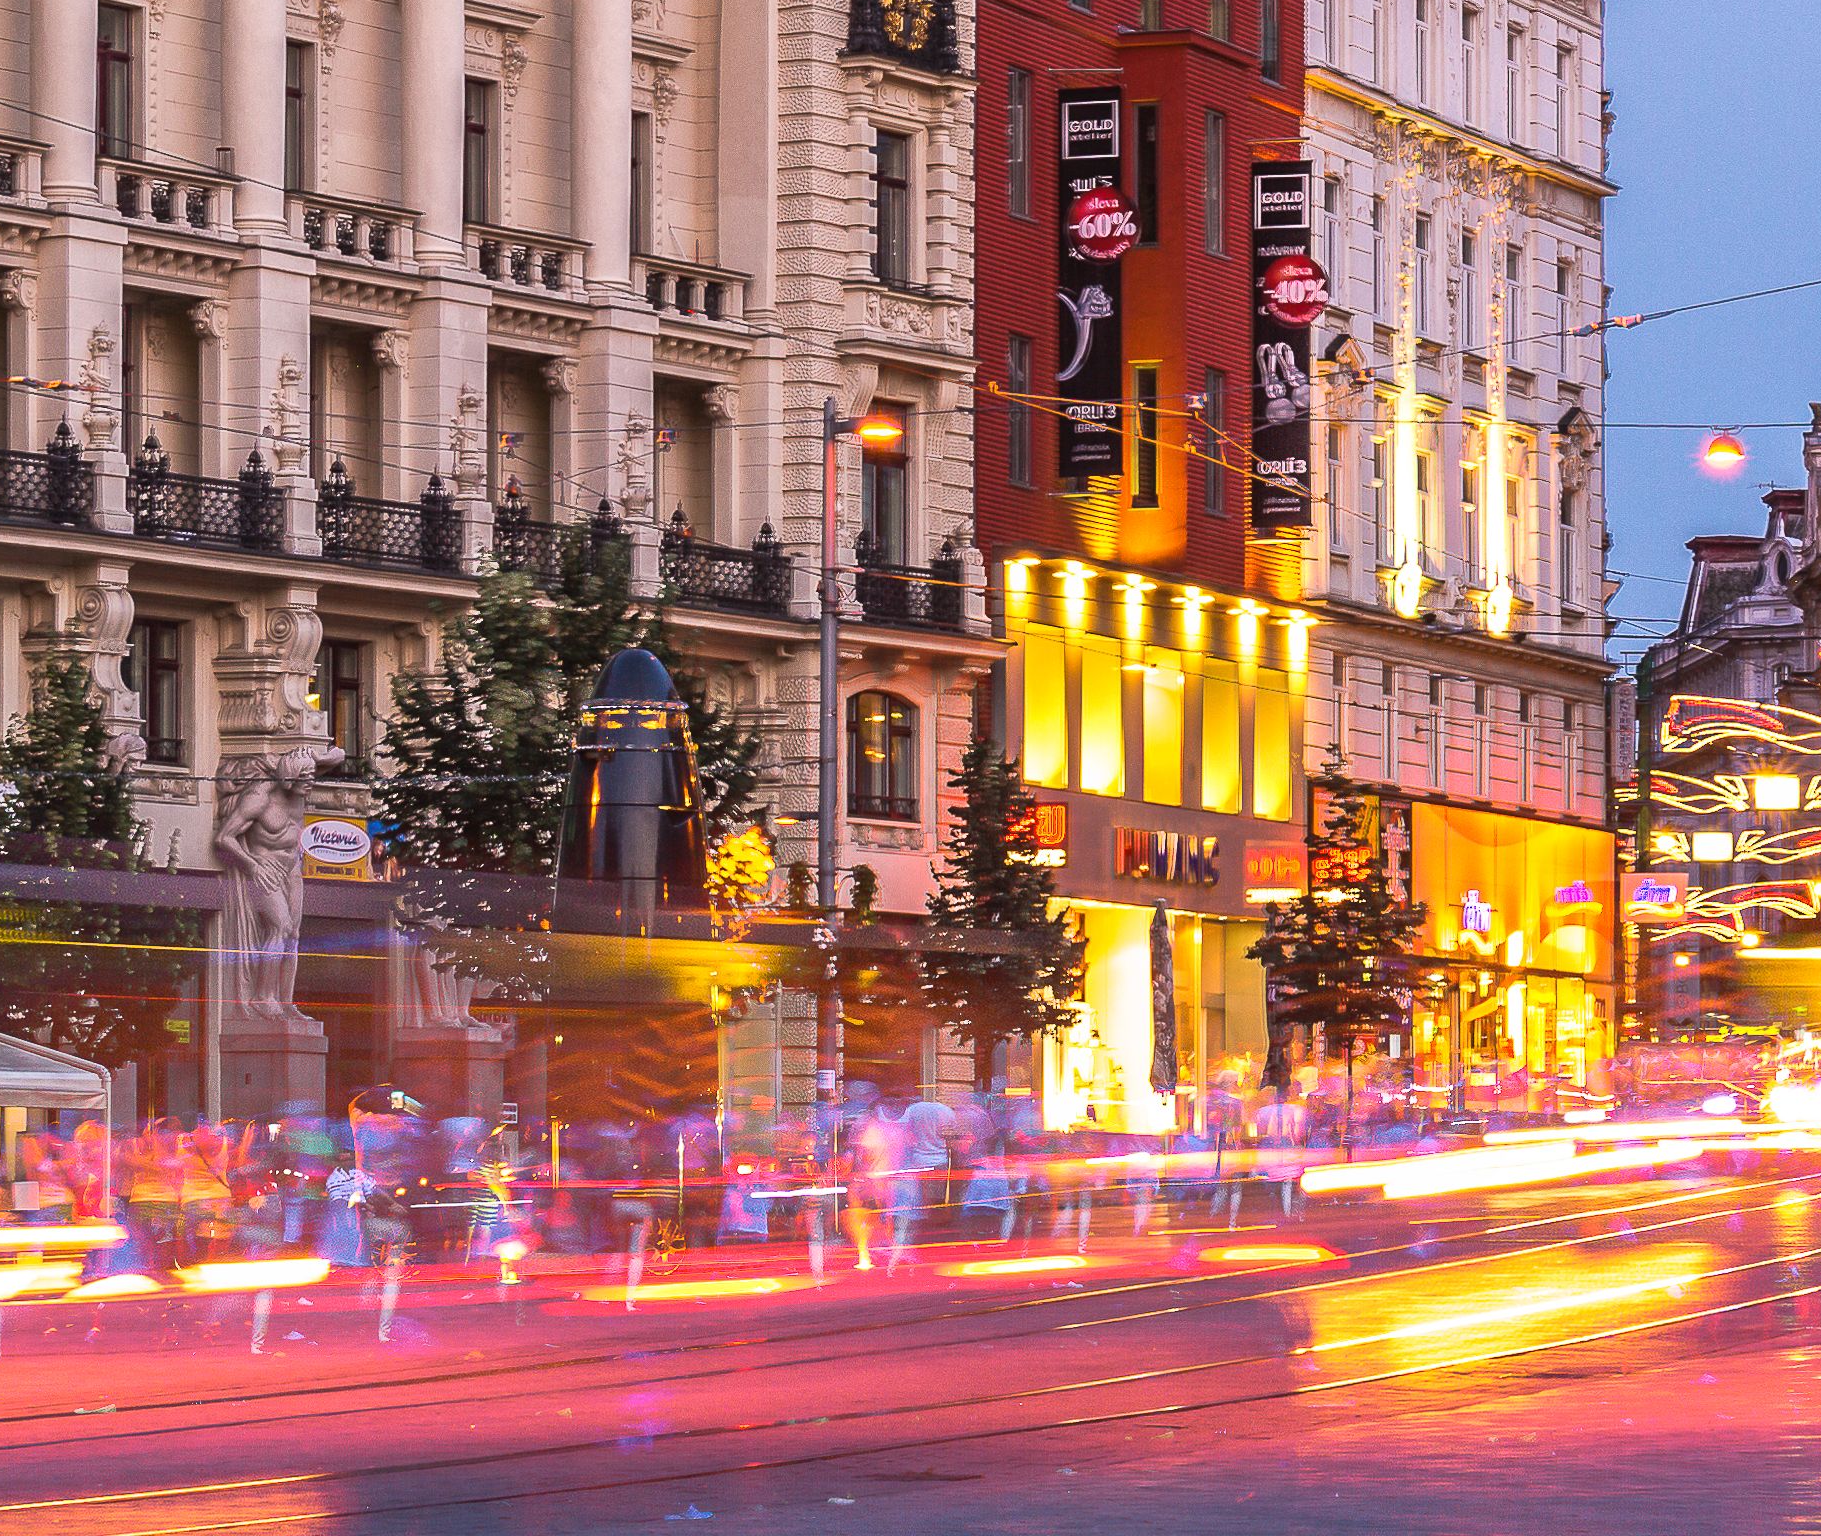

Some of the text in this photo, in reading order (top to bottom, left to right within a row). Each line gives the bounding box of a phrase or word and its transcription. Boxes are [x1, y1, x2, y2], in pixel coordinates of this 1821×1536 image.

[1068, 118, 1114, 133] GOLD
[1068, 131, 1113, 141] atelier
[1261, 190, 1305, 204] GOLD
[1069, 210, 1137, 239] -60%
[1264, 278, 1329, 304] -40%
